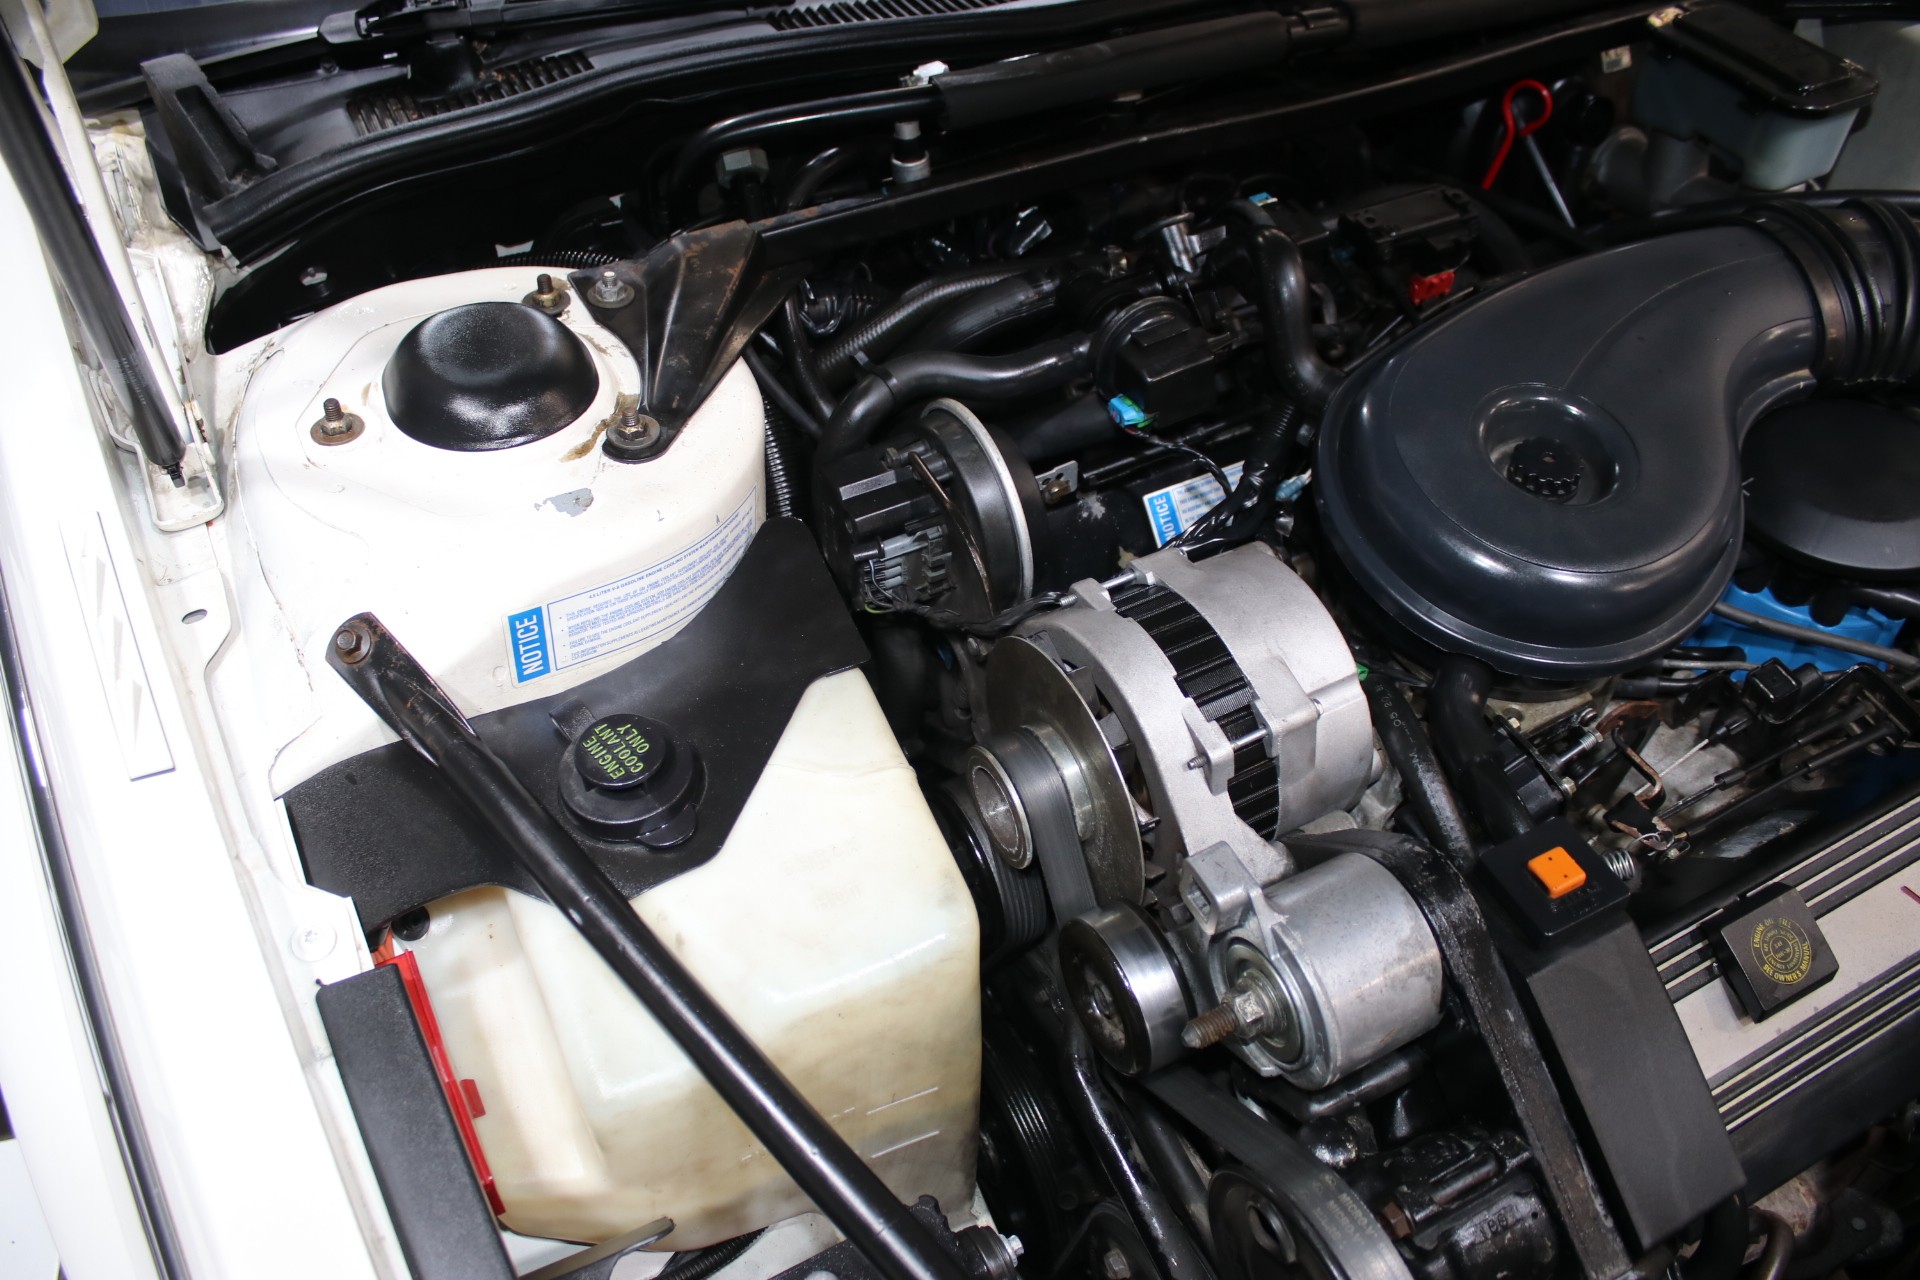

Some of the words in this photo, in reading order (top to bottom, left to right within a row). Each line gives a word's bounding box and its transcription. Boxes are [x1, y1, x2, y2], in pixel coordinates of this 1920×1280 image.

[1154, 495, 1176, 541] NOTICE
[620, 577, 644, 588] GASOLINE
[646, 568, 662, 577] ENGINE
[663, 558, 683, 570] COOLING
[684, 548, 698, 559] SYSTEM
[516, 614, 543, 675] NOTICE
[582, 736, 625, 779] ENGINE
[594, 723, 644, 773] COOLANT
[616, 723, 650, 753] ONLY
[1753, 922, 1765, 948] ENGINE
[1762, 963, 1774, 976] SEE
[1774, 970, 1802, 982] OWNER'S
[1800, 941, 1810, 972] MANUAL
